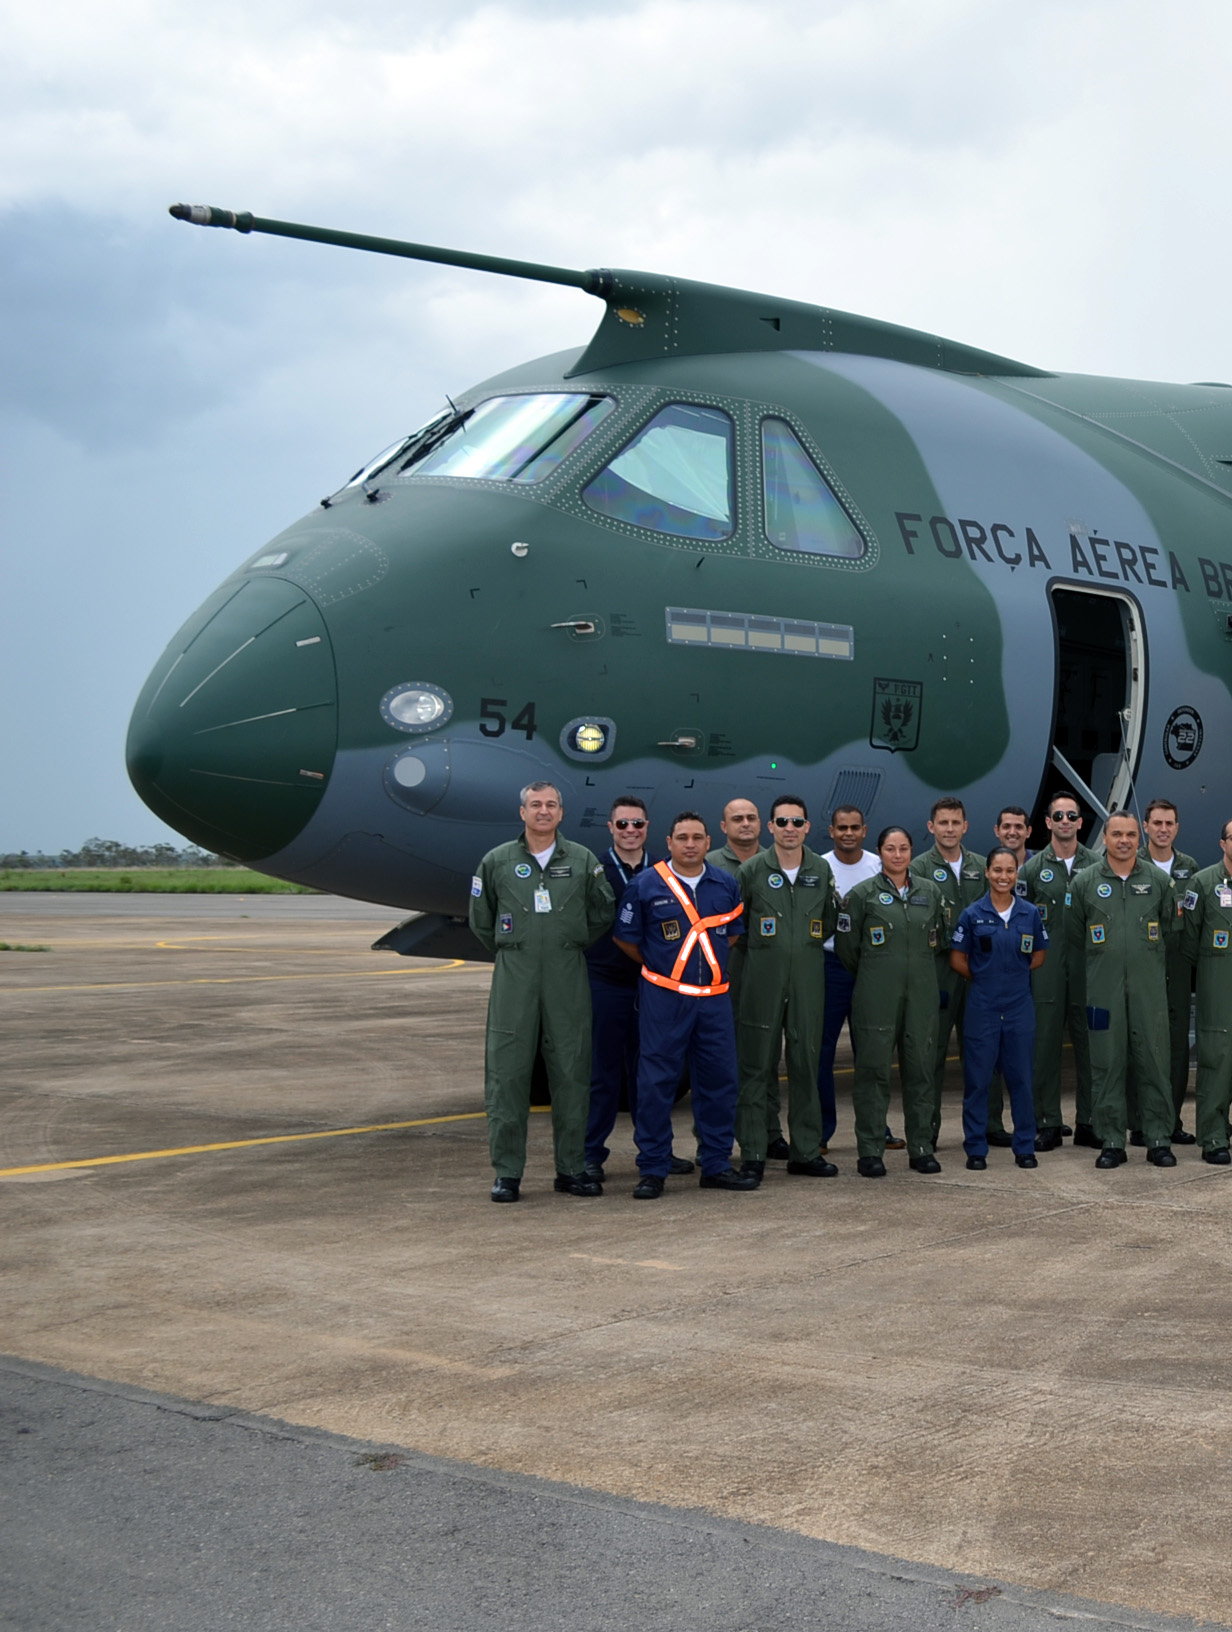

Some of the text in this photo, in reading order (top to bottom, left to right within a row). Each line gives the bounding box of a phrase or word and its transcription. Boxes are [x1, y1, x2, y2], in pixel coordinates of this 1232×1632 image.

[894, 511, 1052, 573] FORÇA
[1068, 529, 1191, 592] AÉREA
[479, 697, 538, 741] 54
[1177, 732, 1195, 744] 22
